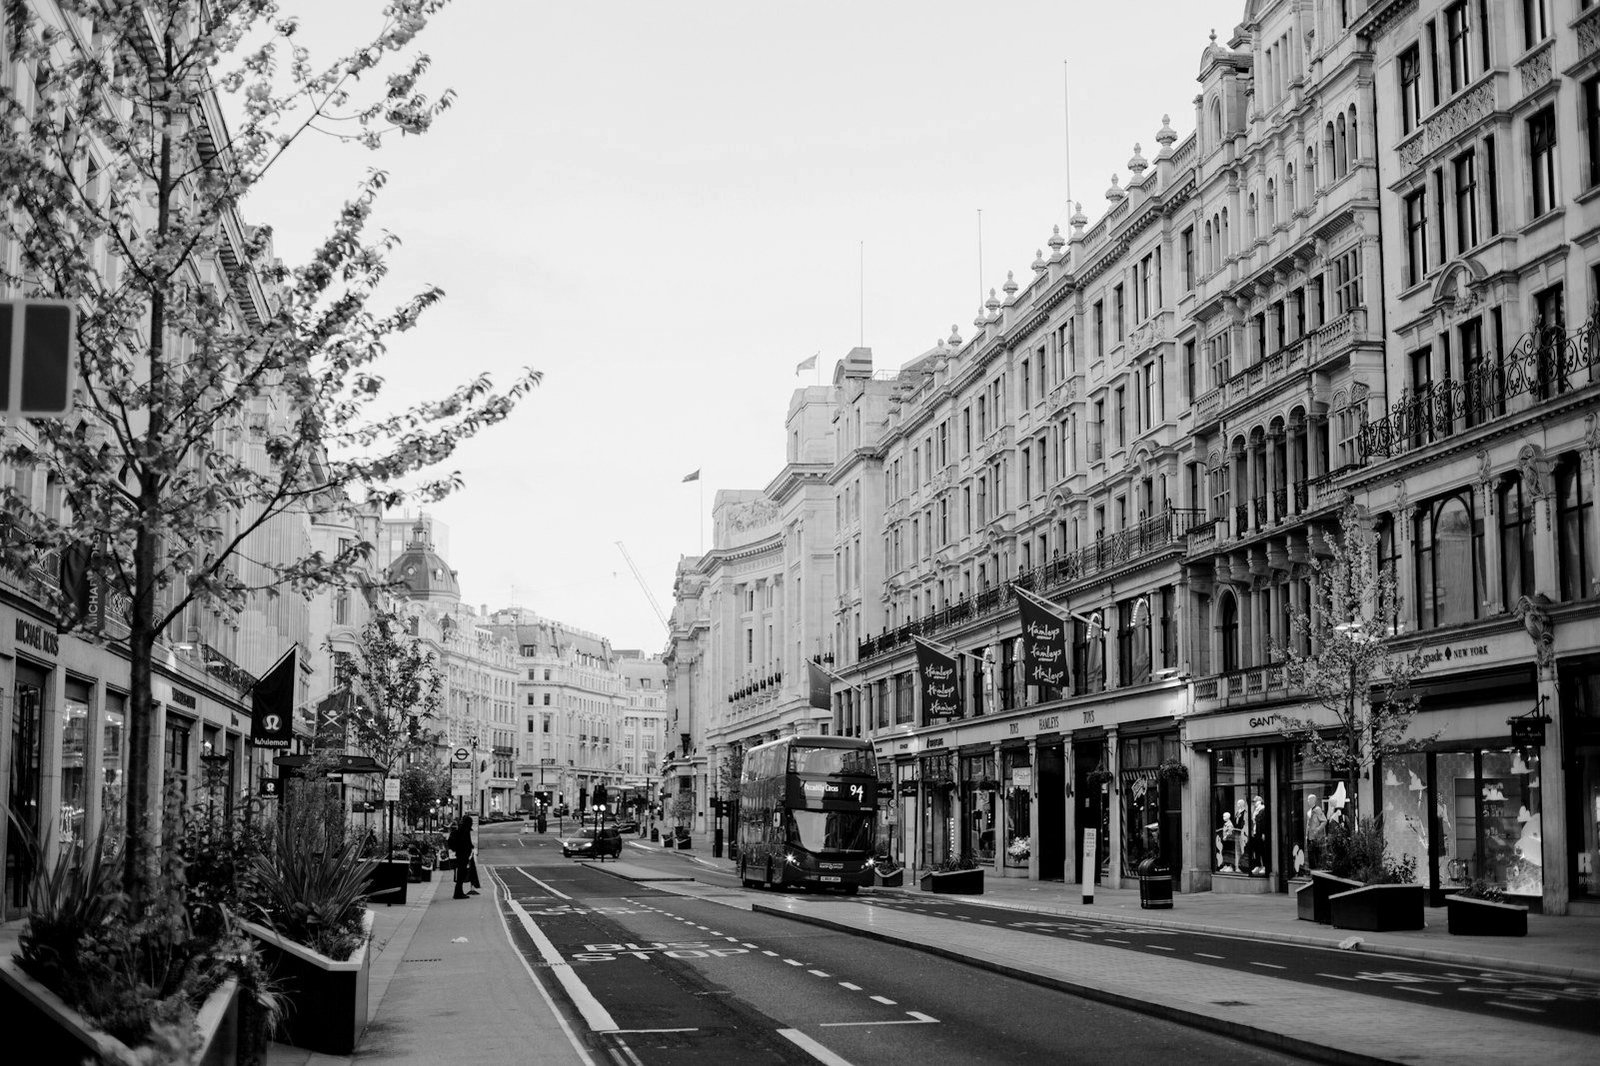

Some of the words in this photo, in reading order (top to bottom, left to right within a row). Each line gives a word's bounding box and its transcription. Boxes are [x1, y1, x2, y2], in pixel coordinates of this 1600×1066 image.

[16, 618, 42, 650] MICHAEL
[43, 630, 59, 657] KORS
[1027, 620, 1060, 641] Hamleys
[1453, 650, 1469, 660] NEW
[1470, 645, 1489, 657] YORK
[1039, 716, 1060, 731] HAMLEYS
[1083, 710, 1096, 724] TOYS
[1249, 715, 1275, 729] GANT
[1009, 722, 1019, 735] TOYS
[850, 784, 864, 803] 94
[583, 942, 710, 951] BUS
[571, 949, 750, 961] STOP
